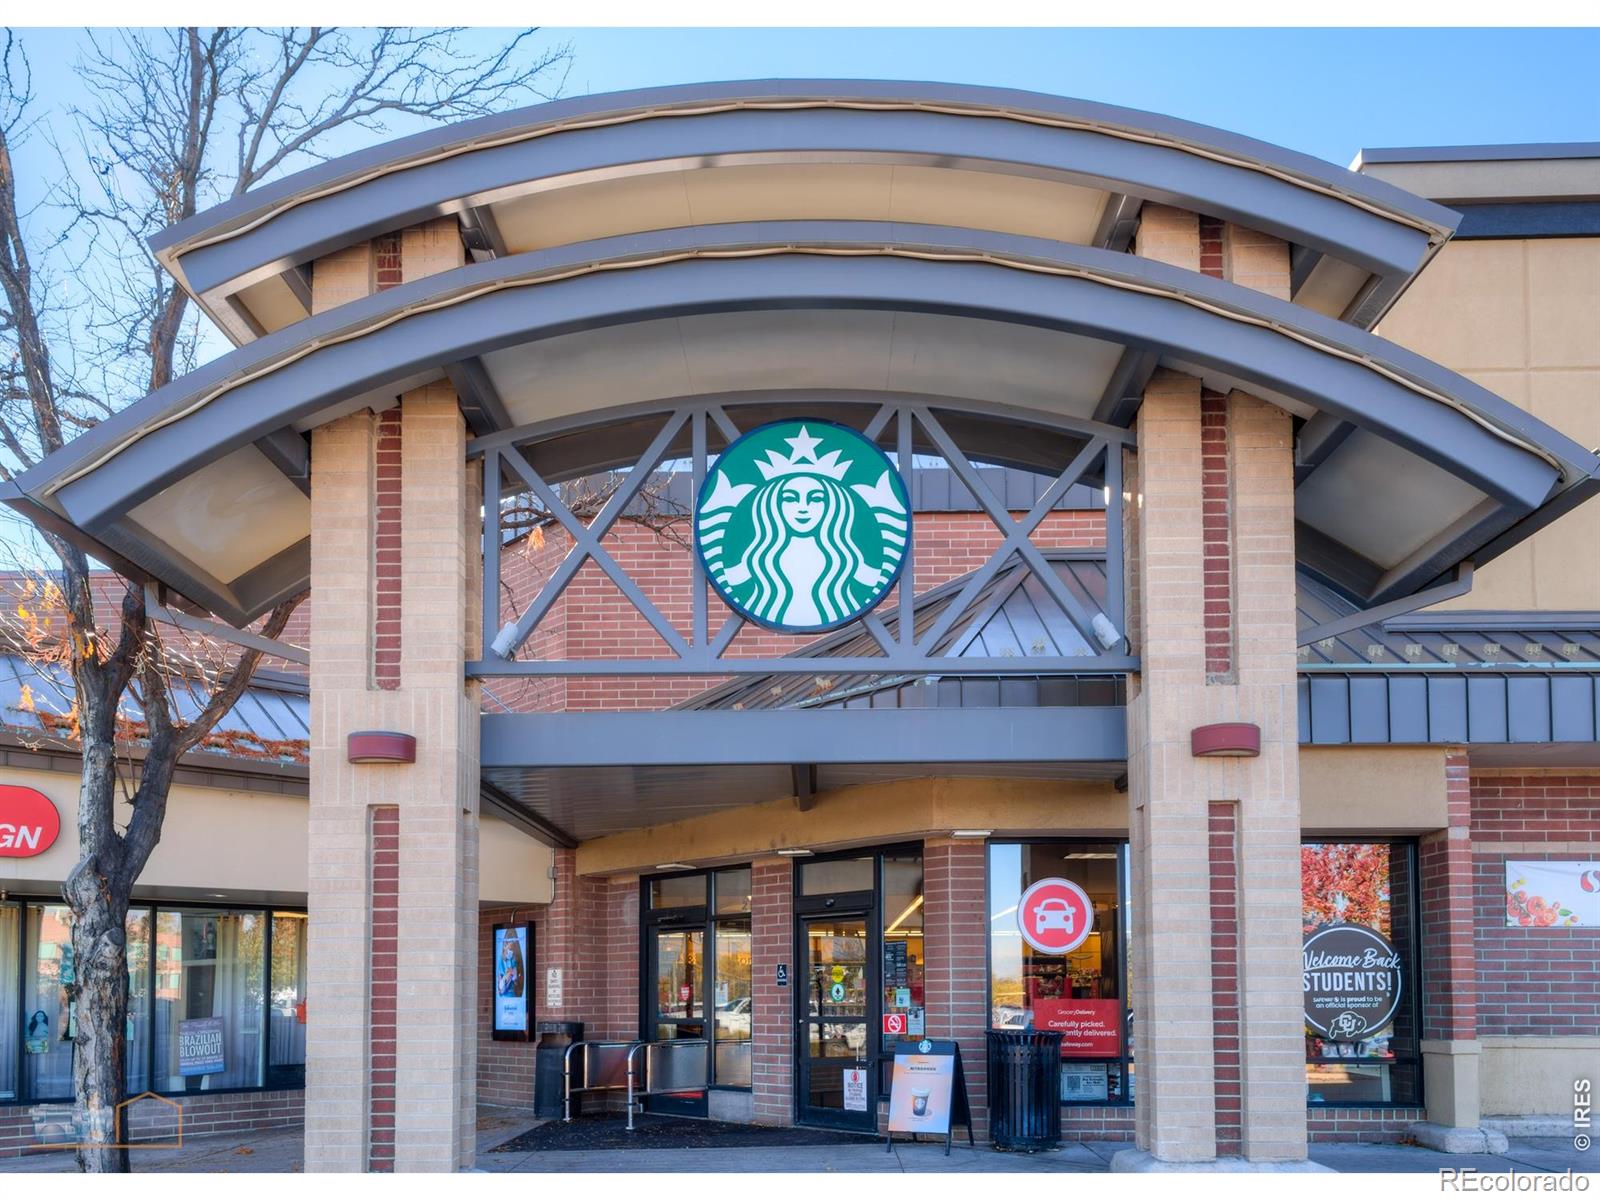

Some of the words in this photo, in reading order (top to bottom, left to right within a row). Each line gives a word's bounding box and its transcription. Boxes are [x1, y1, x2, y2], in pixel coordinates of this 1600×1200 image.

[1362, 948, 1400, 969] Back
[1303, 971, 1392, 992] STUDENTS!
[1048, 1020, 1079, 1029] Carefully
[1080, 1020, 1105, 1029] picked.
[179, 1032, 222, 1046] BRAZILIAN
[1083, 1029, 1117, 1037] delivered.
[180, 1043, 221, 1057] BLOWOUT
